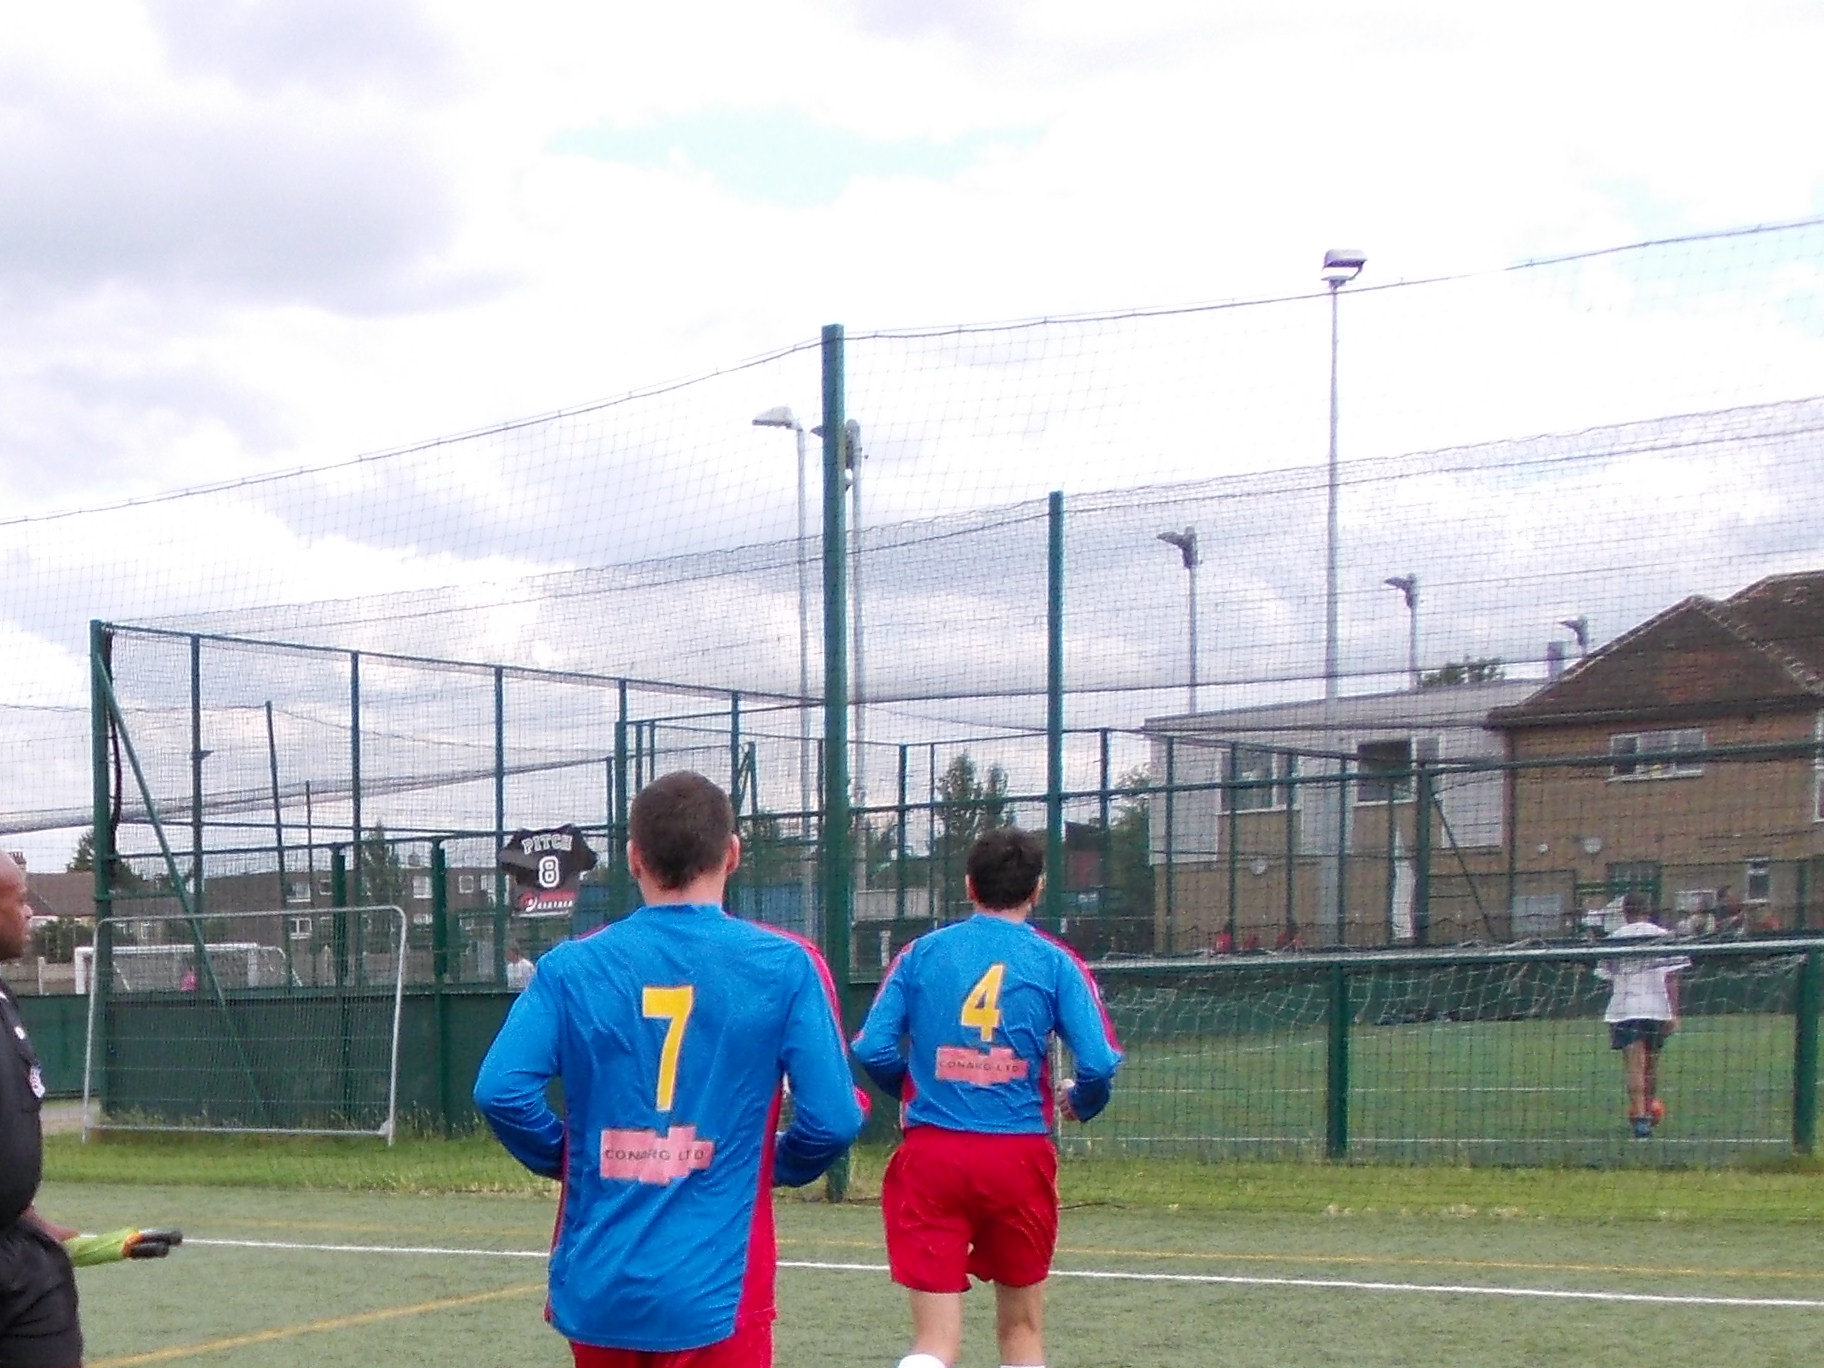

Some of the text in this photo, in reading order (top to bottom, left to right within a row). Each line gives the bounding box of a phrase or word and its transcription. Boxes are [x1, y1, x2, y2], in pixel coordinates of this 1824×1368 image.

[521, 833, 573, 855] PITCH
[538, 855, 560, 888] 8
[960, 962, 1005, 1042] 4
[642, 985, 695, 1112] 7
[678, 1149, 705, 1161] LTD
